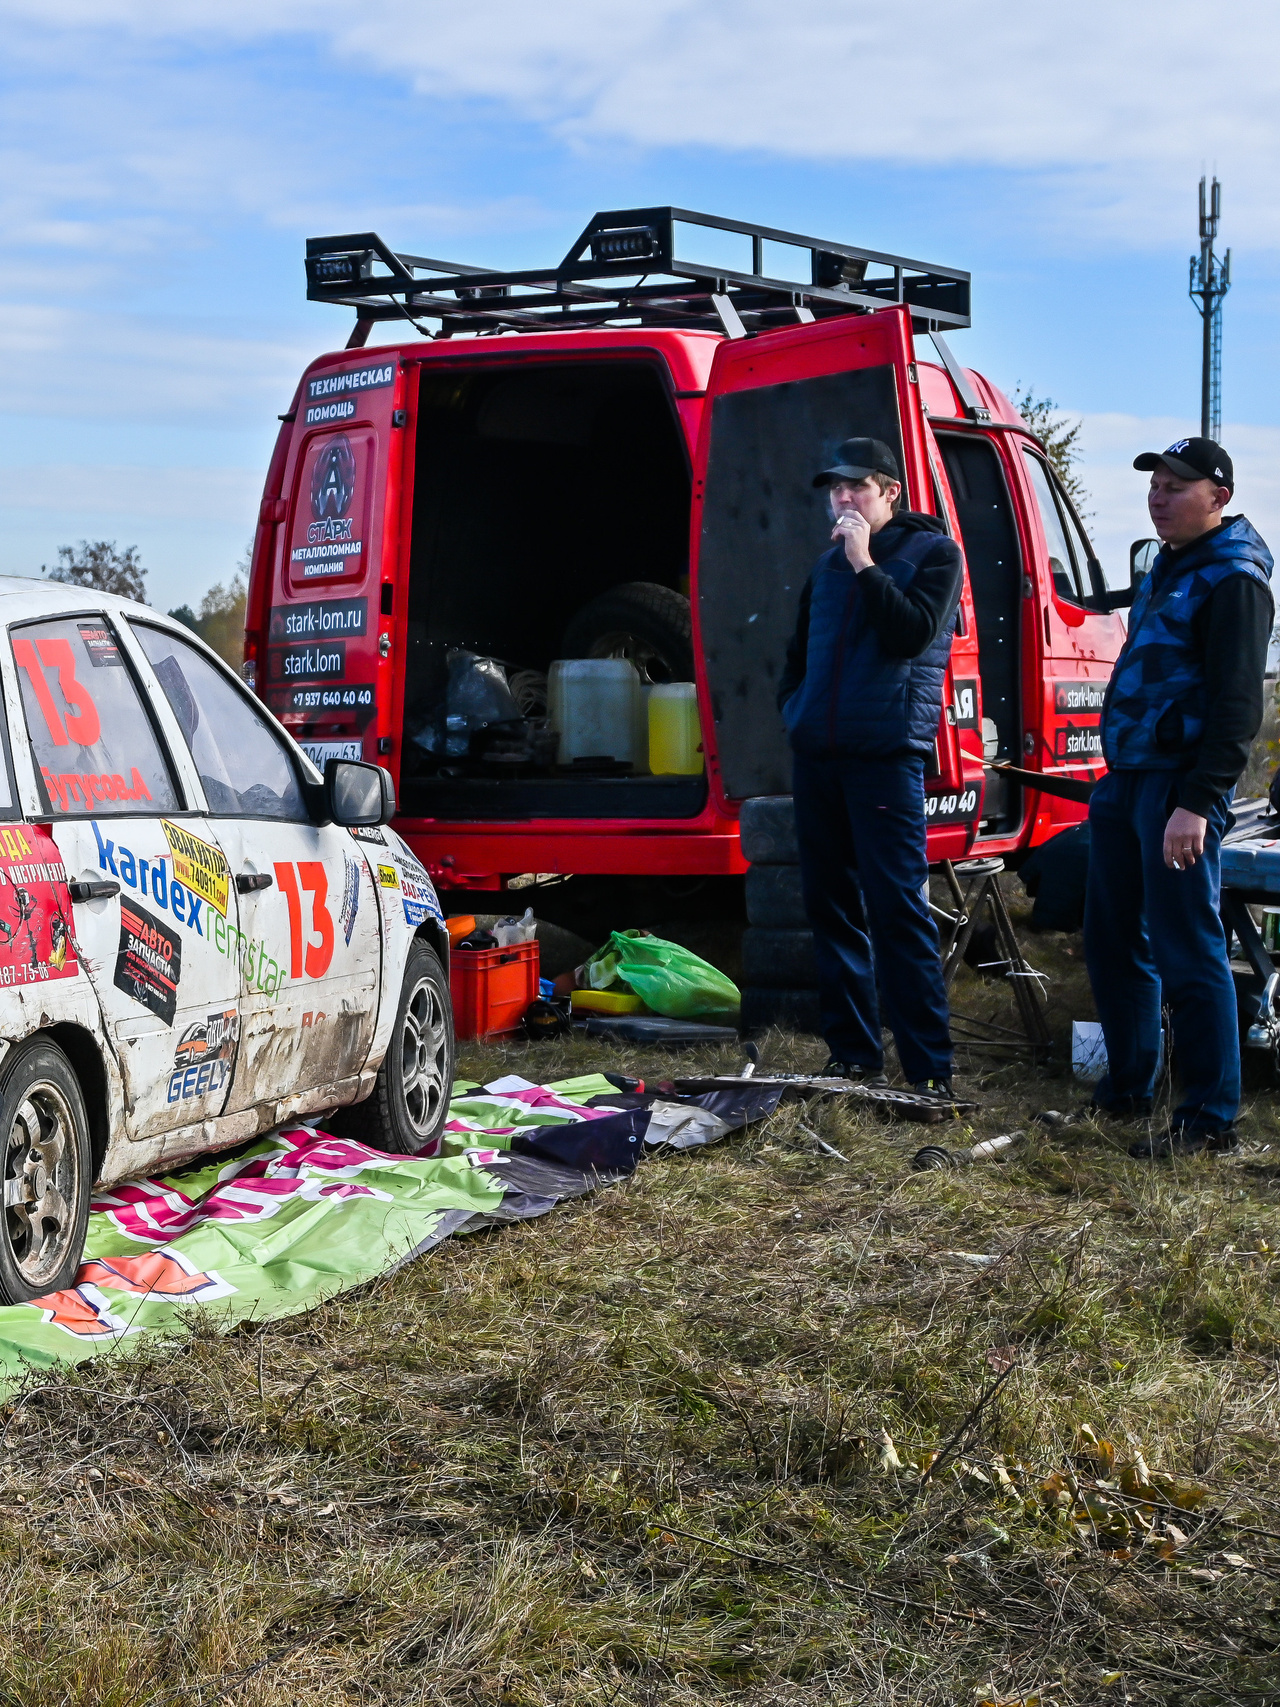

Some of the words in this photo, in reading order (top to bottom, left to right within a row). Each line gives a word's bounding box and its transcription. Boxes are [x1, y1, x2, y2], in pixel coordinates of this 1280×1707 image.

[310, 367, 392, 396] ТЕХНИЧЕСКАЯ
[307, 402, 354, 422] ПОМОЩЬ
[307, 516, 353, 543] СТАРК
[292, 541, 362, 560] МЕТАЛЛОЛОМНАЯ
[304, 561, 344, 576] КОМПАНИЯ
[286, 607, 362, 634] stark-lom.ru
[285, 648, 341, 675] stark.lom
[11, 638, 101, 747] 13
[294, 692, 304, 706] +7
[305, 692, 321, 706] 937
[323, 691, 340, 706] 640
[342, 690, 356, 705] 40
[358, 690, 371, 704] 40
[939, 795, 957, 814] 40
[958, 790, 976, 812] 40
[8, 862, 67, 884] ИНСТРУМЕНТА
[273, 861, 334, 979] 13
[128, 933, 171, 978] ЗАПЧАСТИ
[140, 923, 173, 961] АВТО
[167, 1060, 229, 1103] GEELY
